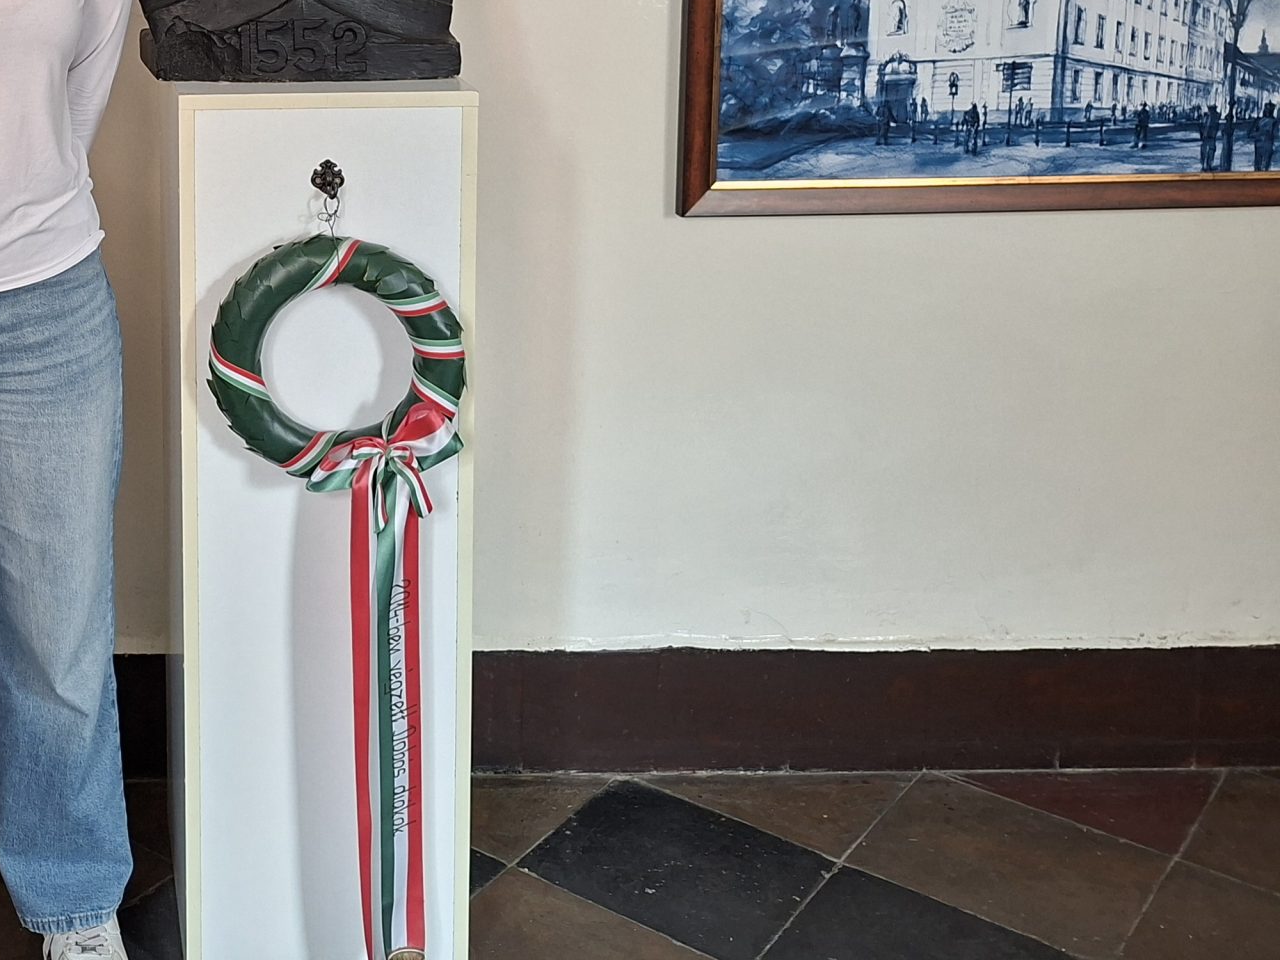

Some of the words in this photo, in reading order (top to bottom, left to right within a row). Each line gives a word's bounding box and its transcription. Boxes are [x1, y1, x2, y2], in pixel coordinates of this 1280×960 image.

[238, 19, 369, 74] 1552
[387, 579, 411, 659] 2014-ben
[384, 659, 418, 723] végzett
